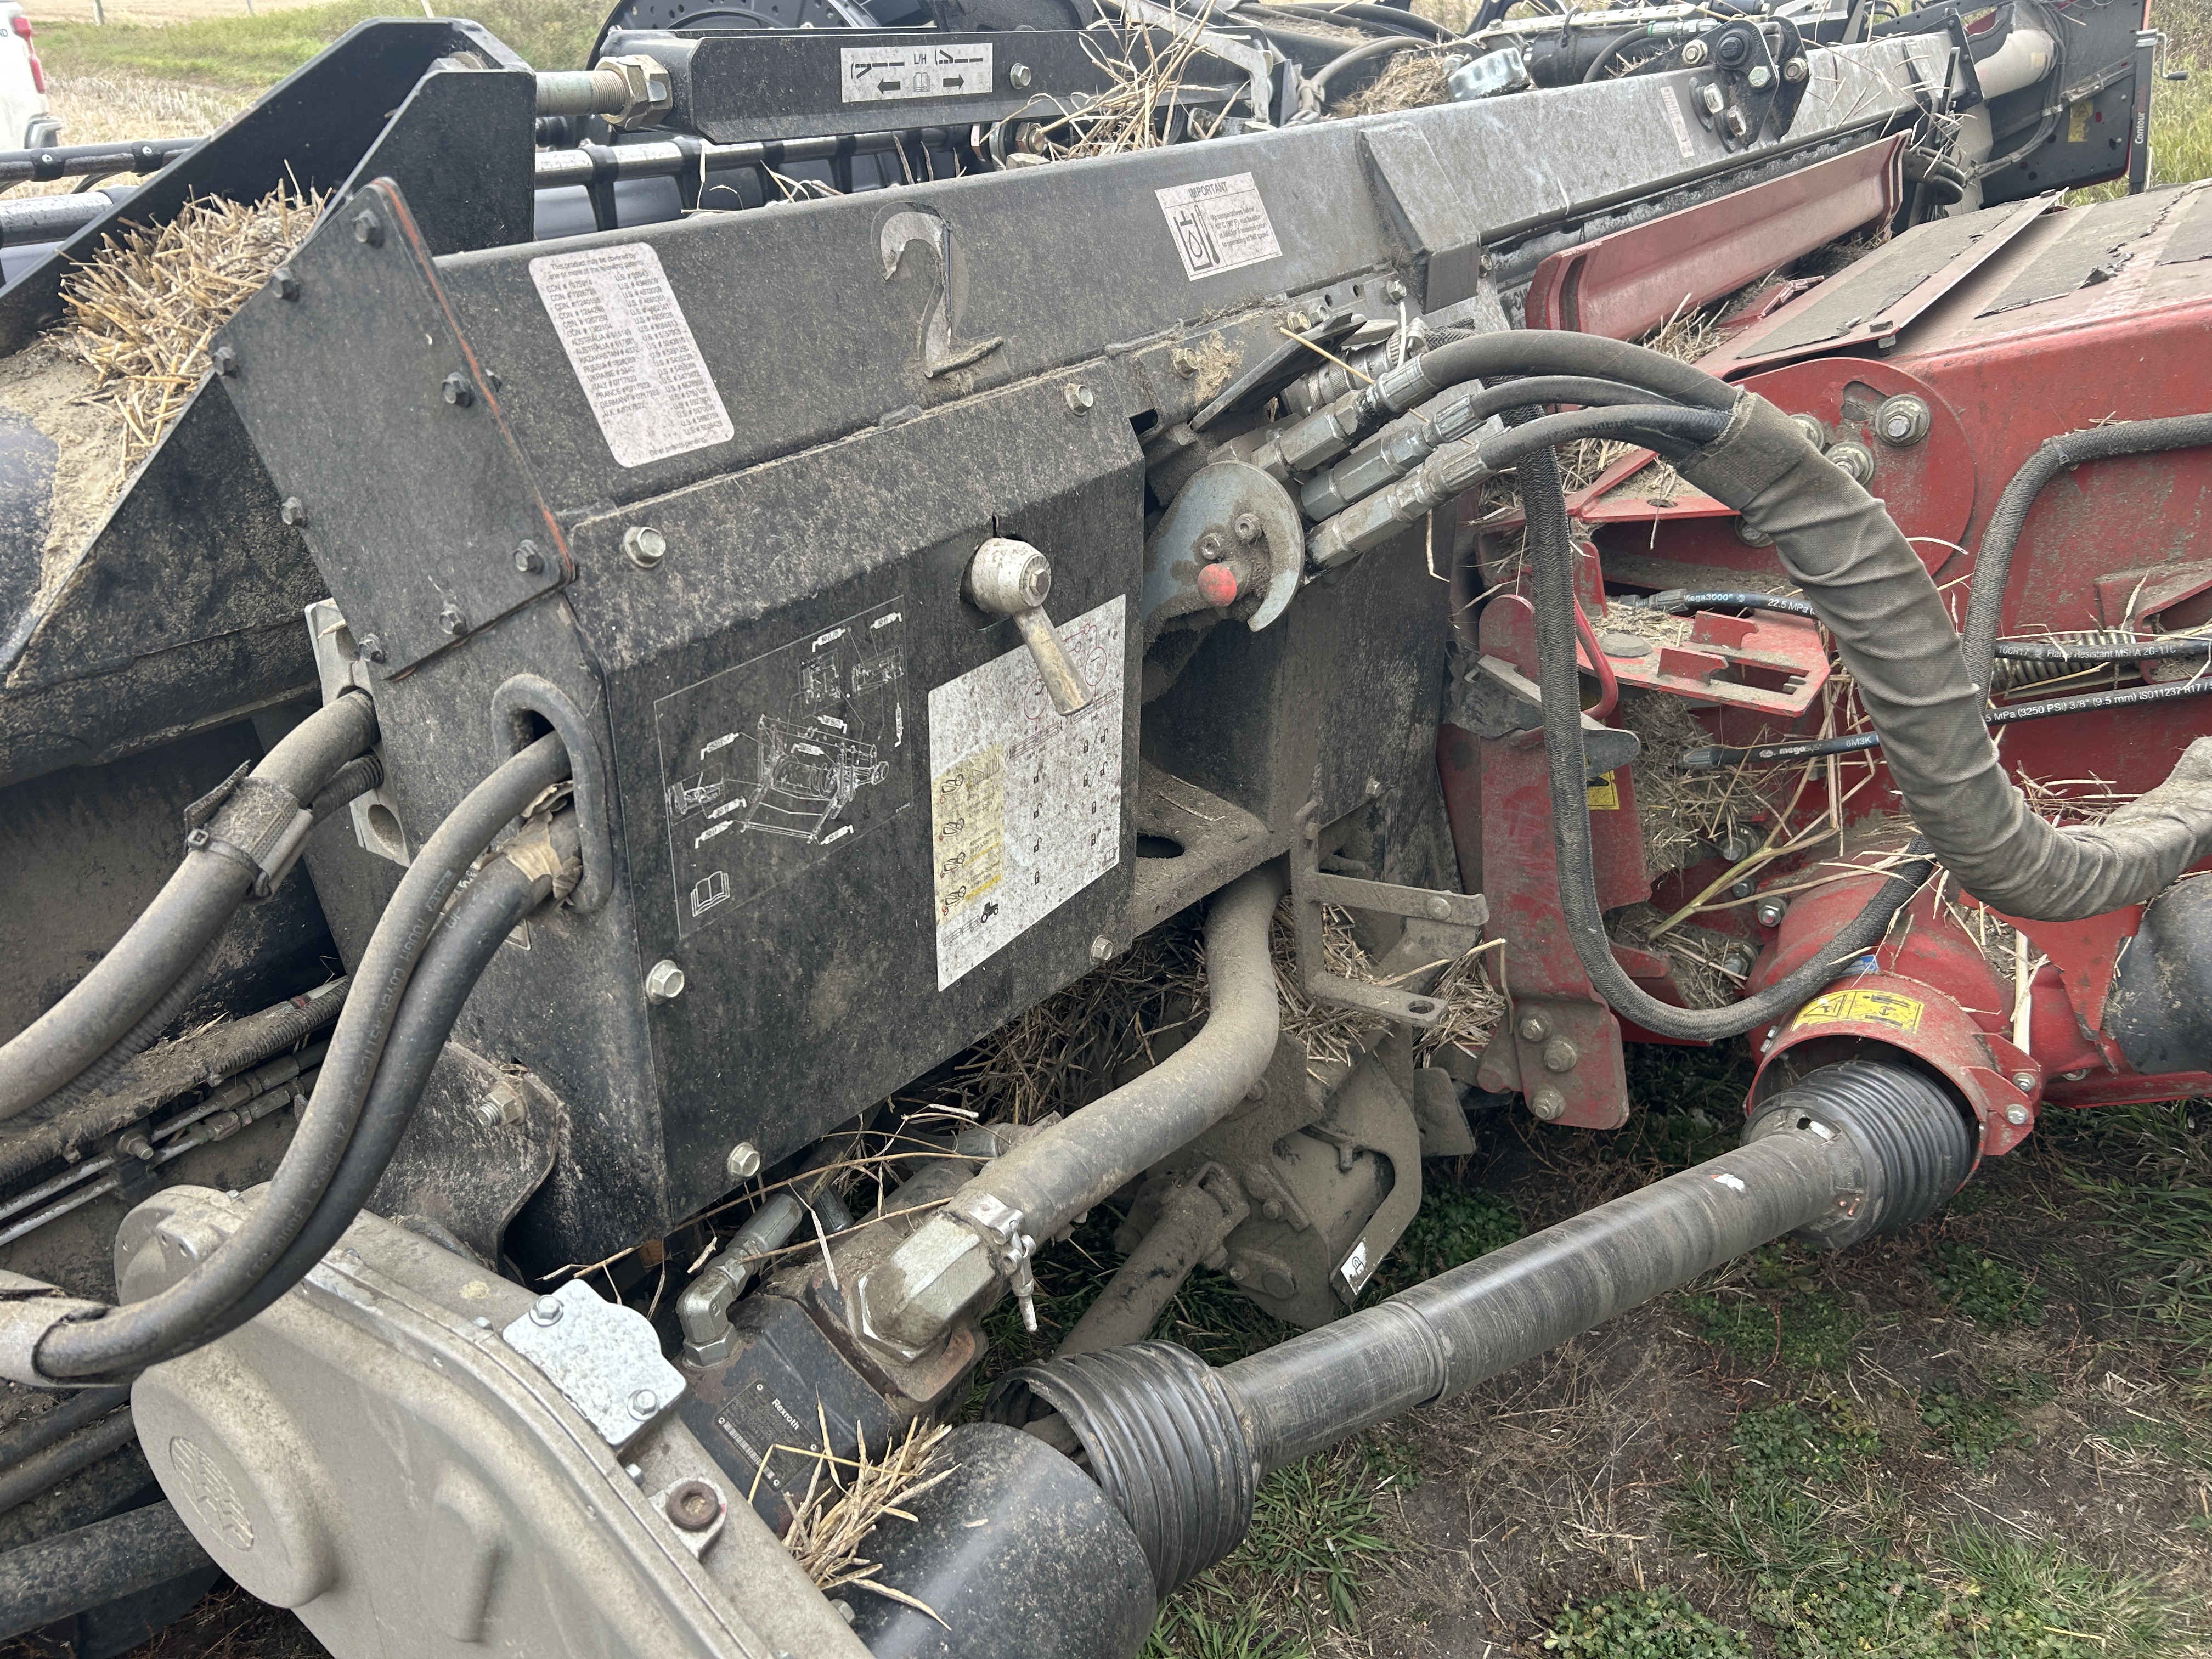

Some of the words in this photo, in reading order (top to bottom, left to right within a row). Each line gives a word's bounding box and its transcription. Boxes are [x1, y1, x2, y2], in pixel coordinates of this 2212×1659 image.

[913, 53, 927, 65] L/H
[1188, 182, 1228, 198] IMPORTANT
[571, 334, 606, 346] AUSTRALIA
[574, 343, 610, 354] AUSTRALIA
[579, 351, 620, 364] KAZAKHSTAN
[583, 363, 607, 373] RUSSIA
[587, 371, 616, 381] UKRAINE
[595, 388, 621, 399] FRANCE
[599, 396, 630, 408] GERMANY
[1768, 598, 1787, 608] 22.5
[1788, 602, 1809, 613] MPa
[2115, 648, 2141, 658] MSHA
[1994, 709, 2016, 721] MPa
[2018, 706, 2045, 719] (3250
[2047, 701, 2067, 713] PSI)
[2093, 695, 2112, 708] (9.5
[2114, 693, 2137, 705] mm)
[1846, 735, 1872, 747] 6M3K
[398, 918, 426, 962] TOUGH
[377, 966, 405, 1013] COVER
[771, 1398, 800, 1431] Rexroth
